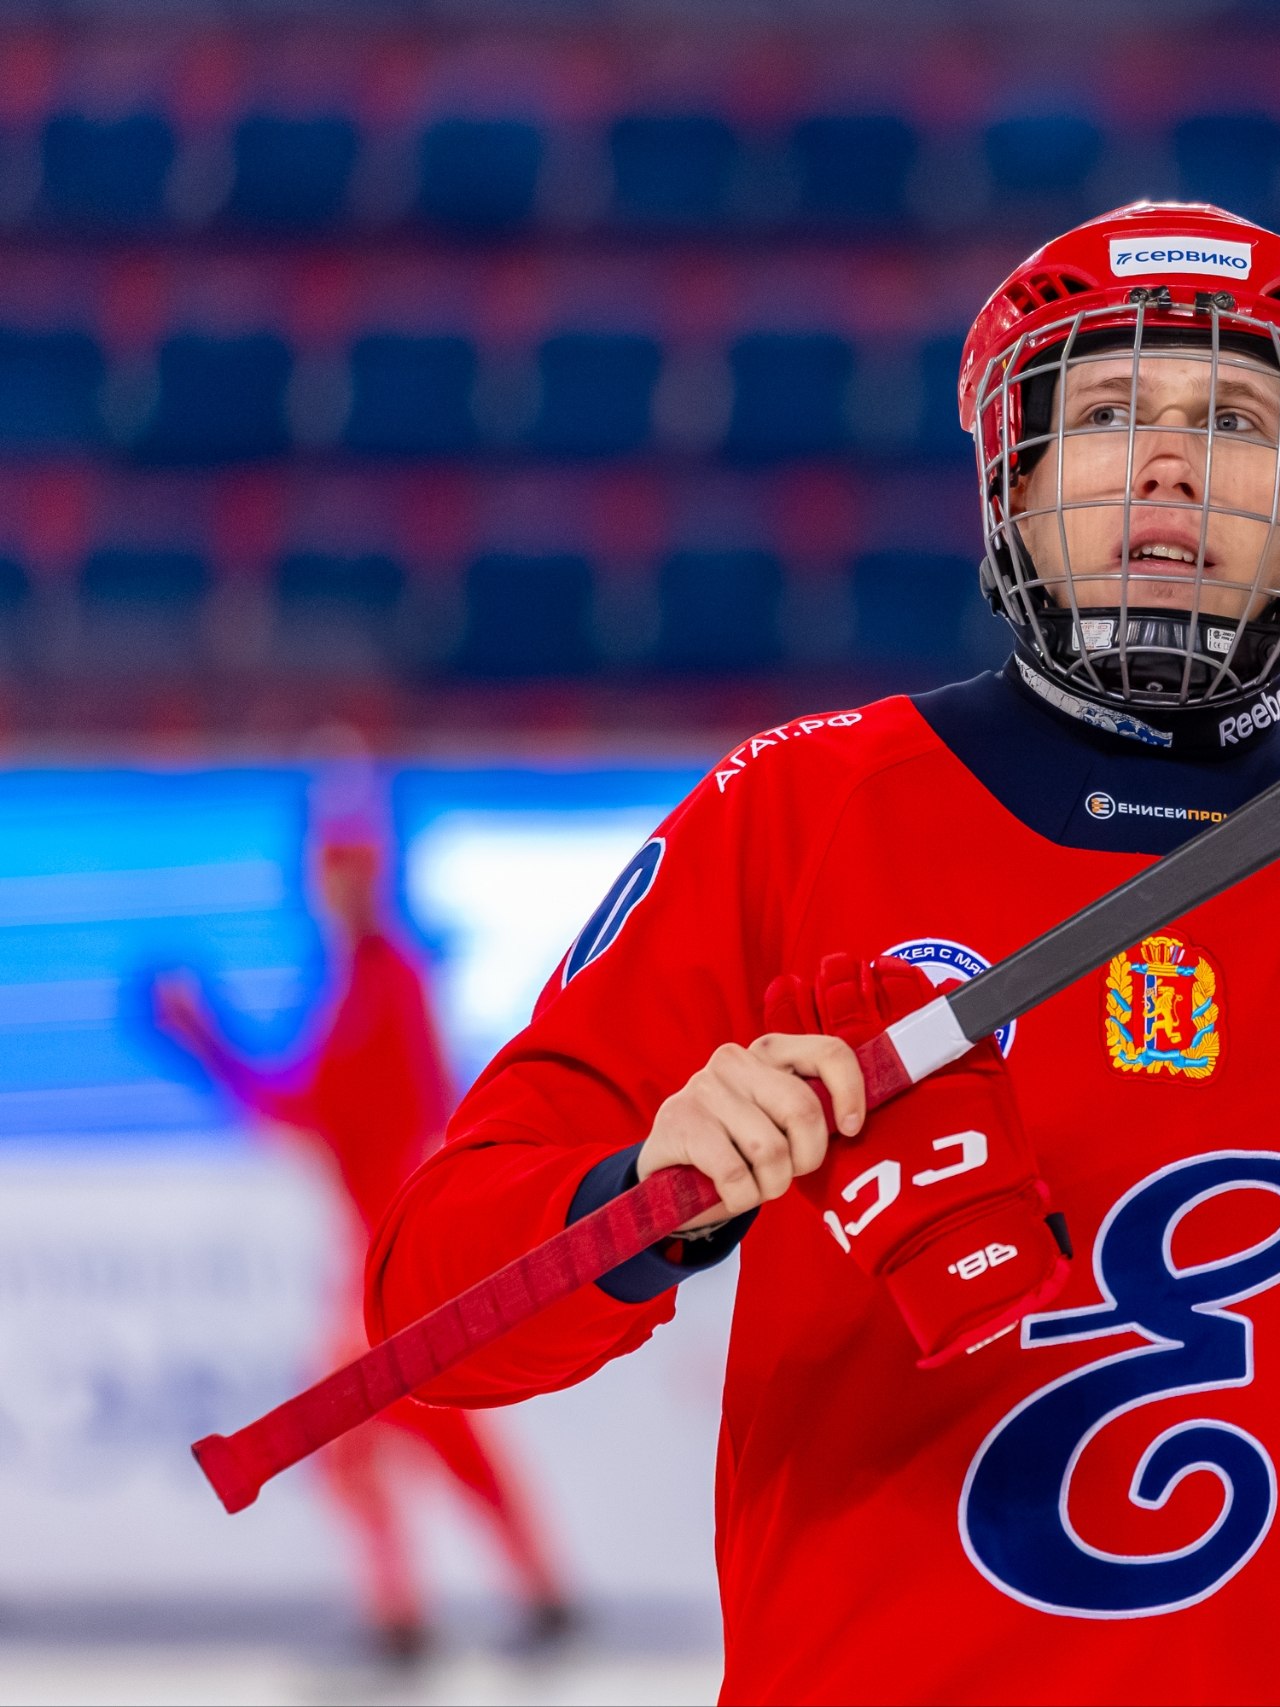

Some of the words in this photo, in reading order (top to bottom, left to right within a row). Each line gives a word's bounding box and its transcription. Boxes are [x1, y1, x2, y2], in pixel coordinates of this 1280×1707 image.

[1135, 249, 1248, 269] сервико
[714, 713, 863, 794] АГАТ.РФ
[1118, 802, 1229, 823] ЕНИСЕЙПРО
[823, 1130, 988, 1253] CC
